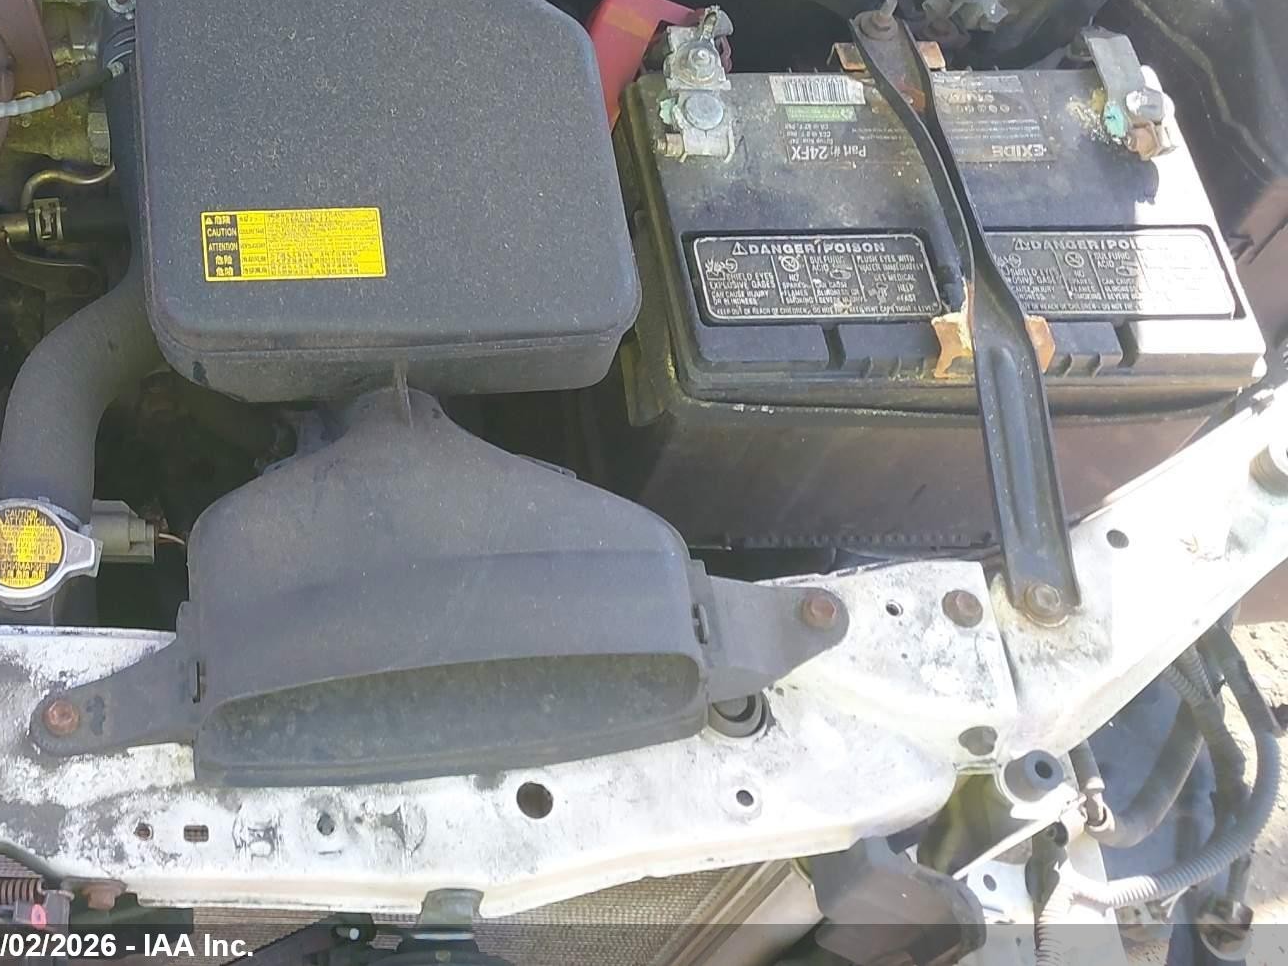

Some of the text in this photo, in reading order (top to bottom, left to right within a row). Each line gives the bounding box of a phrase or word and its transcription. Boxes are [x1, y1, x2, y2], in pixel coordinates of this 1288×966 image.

[791, 145, 828, 160] 24FX
[991, 143, 1045, 158] EXIDE
[206, 228, 237, 238] CAUTION
[208, 242, 238, 252] ATTENTION
[4, 509, 38, 518] CAUTION
[5, 517, 47, 527] ATTENTION
